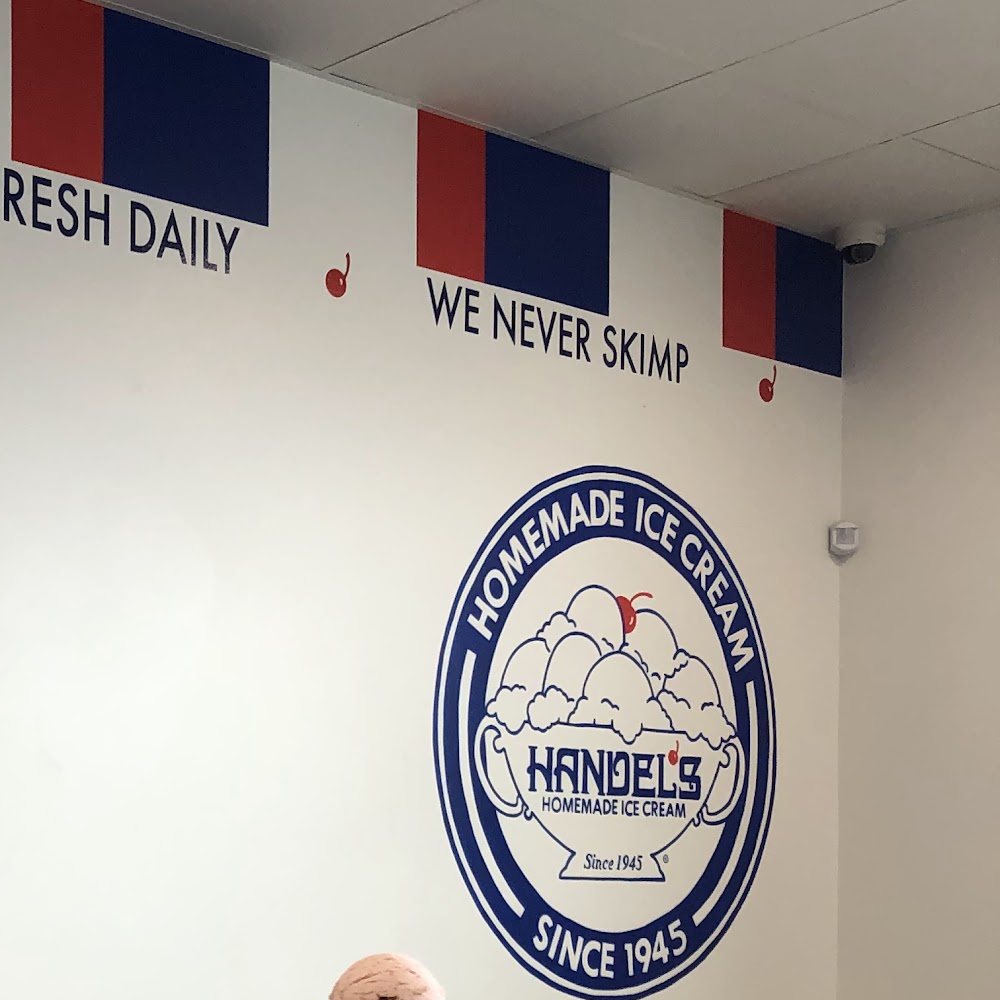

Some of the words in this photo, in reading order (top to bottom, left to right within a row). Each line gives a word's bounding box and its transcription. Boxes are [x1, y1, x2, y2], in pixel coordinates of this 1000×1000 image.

[129, 201, 240, 274] DAILY
[427, 277, 479, 335] WE
[493, 294, 591, 362] NEVER
[602, 325, 689, 384] SKIMP
[466, 489, 625, 641] HOMEMADE
[635, 497, 681, 553] ICE
[680, 533, 755, 673] CREAM
[526, 743, 702, 801] HANDEL'S
[542, 796, 619, 816] HOMEMADE
[621, 798, 641, 817] ICE
[642, 801, 686, 819] CREAM
[583, 853, 614, 871] Since
[616, 854, 643, 871] 1945
[533, 914, 615, 979] SINCE
[624, 919, 688, 976] 1945
